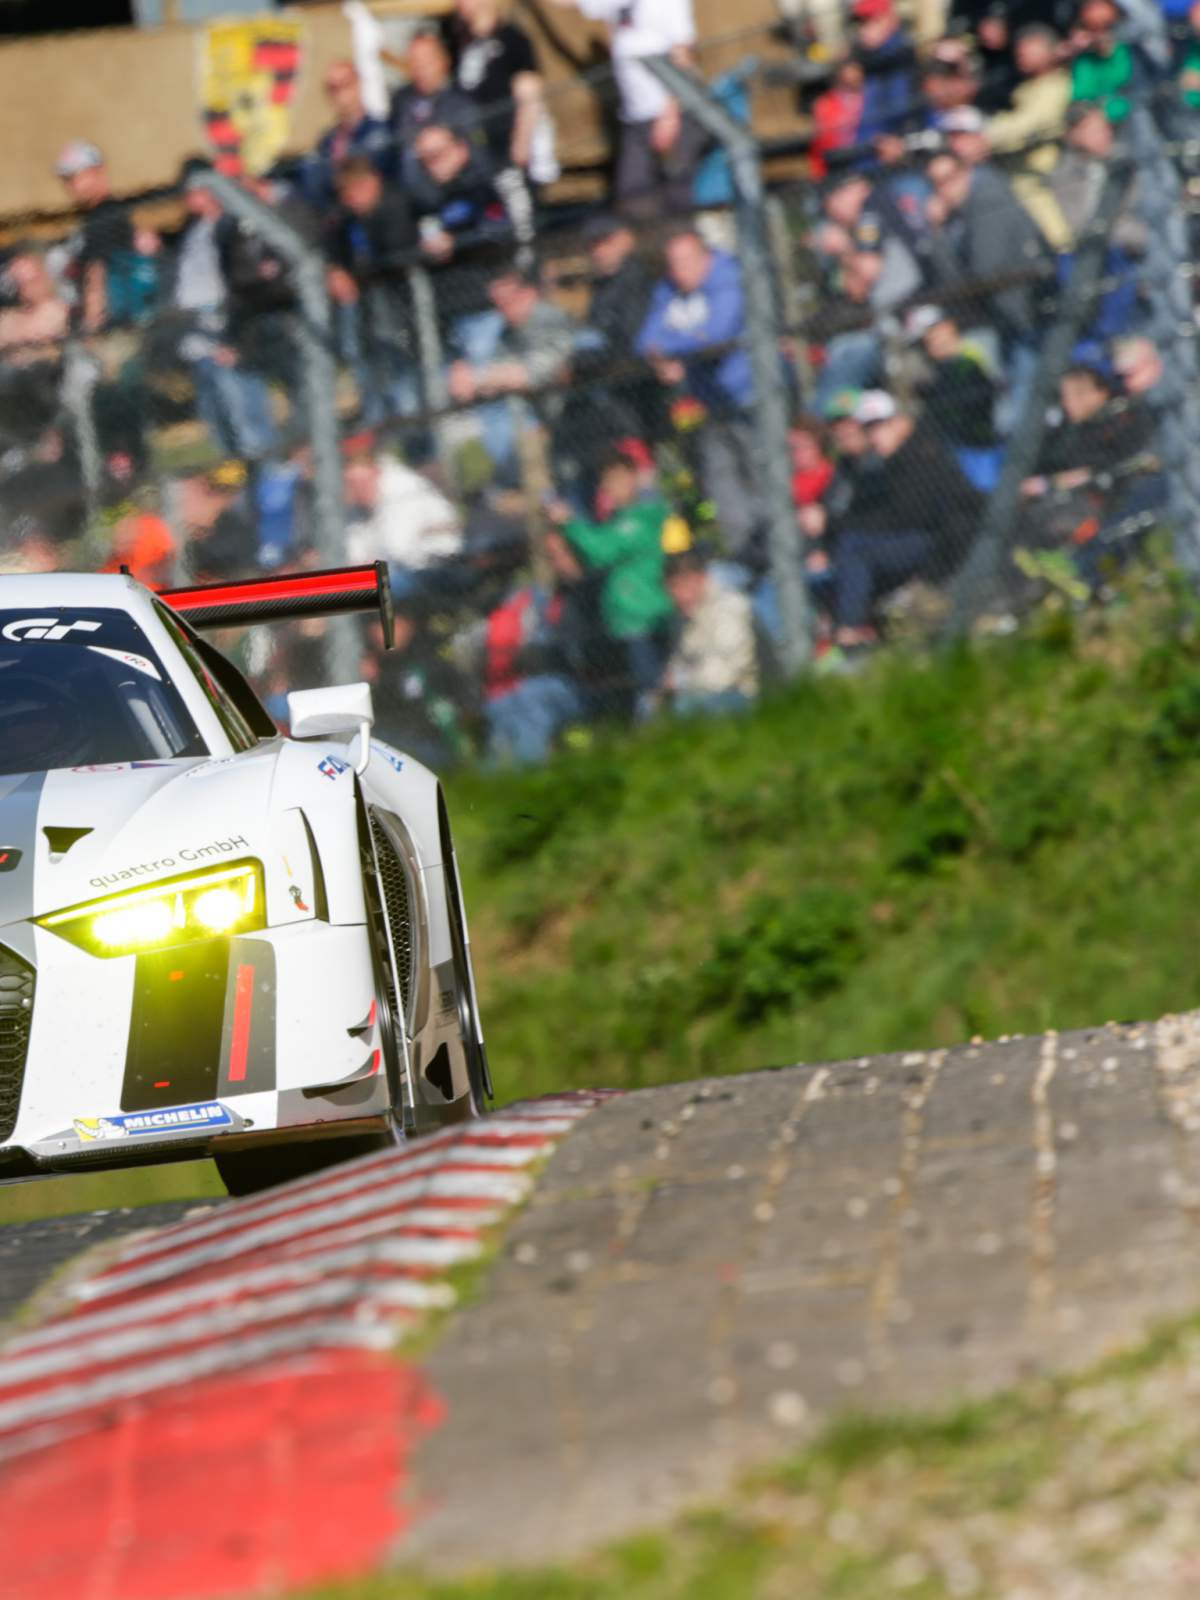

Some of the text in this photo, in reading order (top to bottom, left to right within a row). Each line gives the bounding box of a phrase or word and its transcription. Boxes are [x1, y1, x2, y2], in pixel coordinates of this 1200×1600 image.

[89, 835, 250, 888] quattro GmbH
[123, 1106, 223, 1128] MICHELIN
